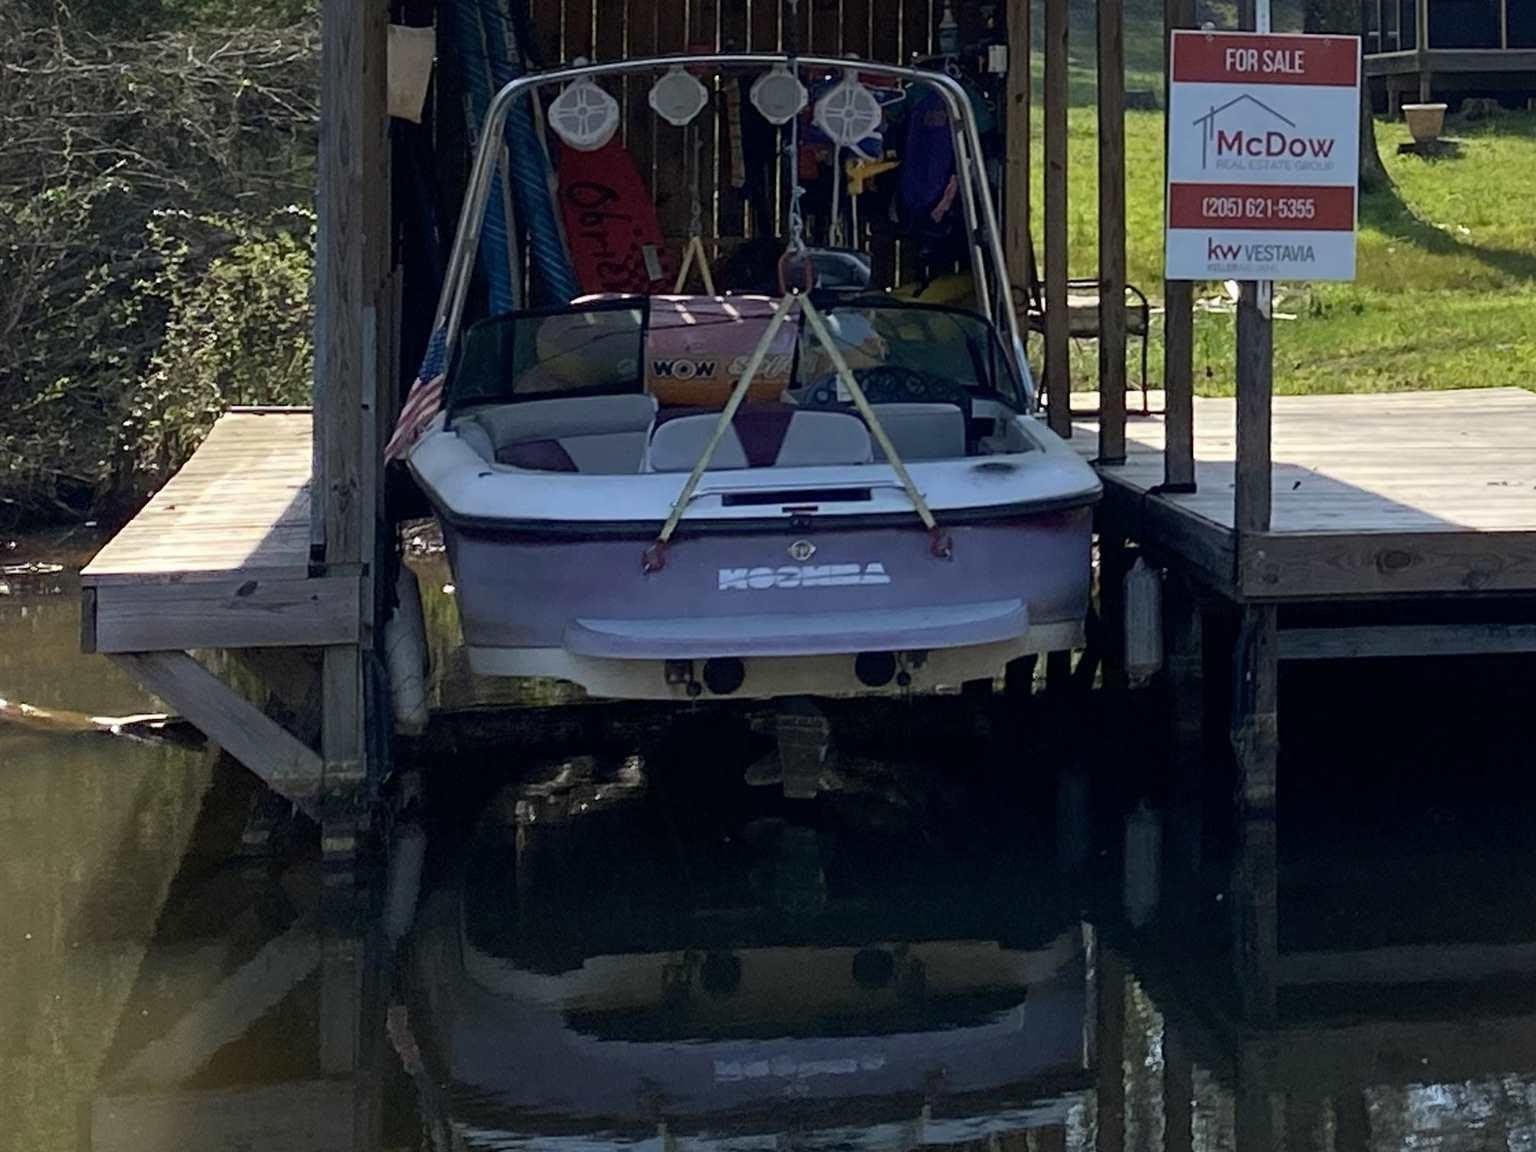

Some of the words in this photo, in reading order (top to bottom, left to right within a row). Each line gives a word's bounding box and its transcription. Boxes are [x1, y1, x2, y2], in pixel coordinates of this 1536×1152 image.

[1226, 48, 1259, 72] FOR
[1262, 50, 1305, 74] SALE
[1216, 130, 1335, 158] McDow
[1202, 197, 1242, 218] (205)
[1245, 198, 1315, 219] 621-5355
[1207, 236, 1242, 261] kw
[1244, 245, 1316, 262] VESTAVIA
[653, 359, 716, 380] WOW
